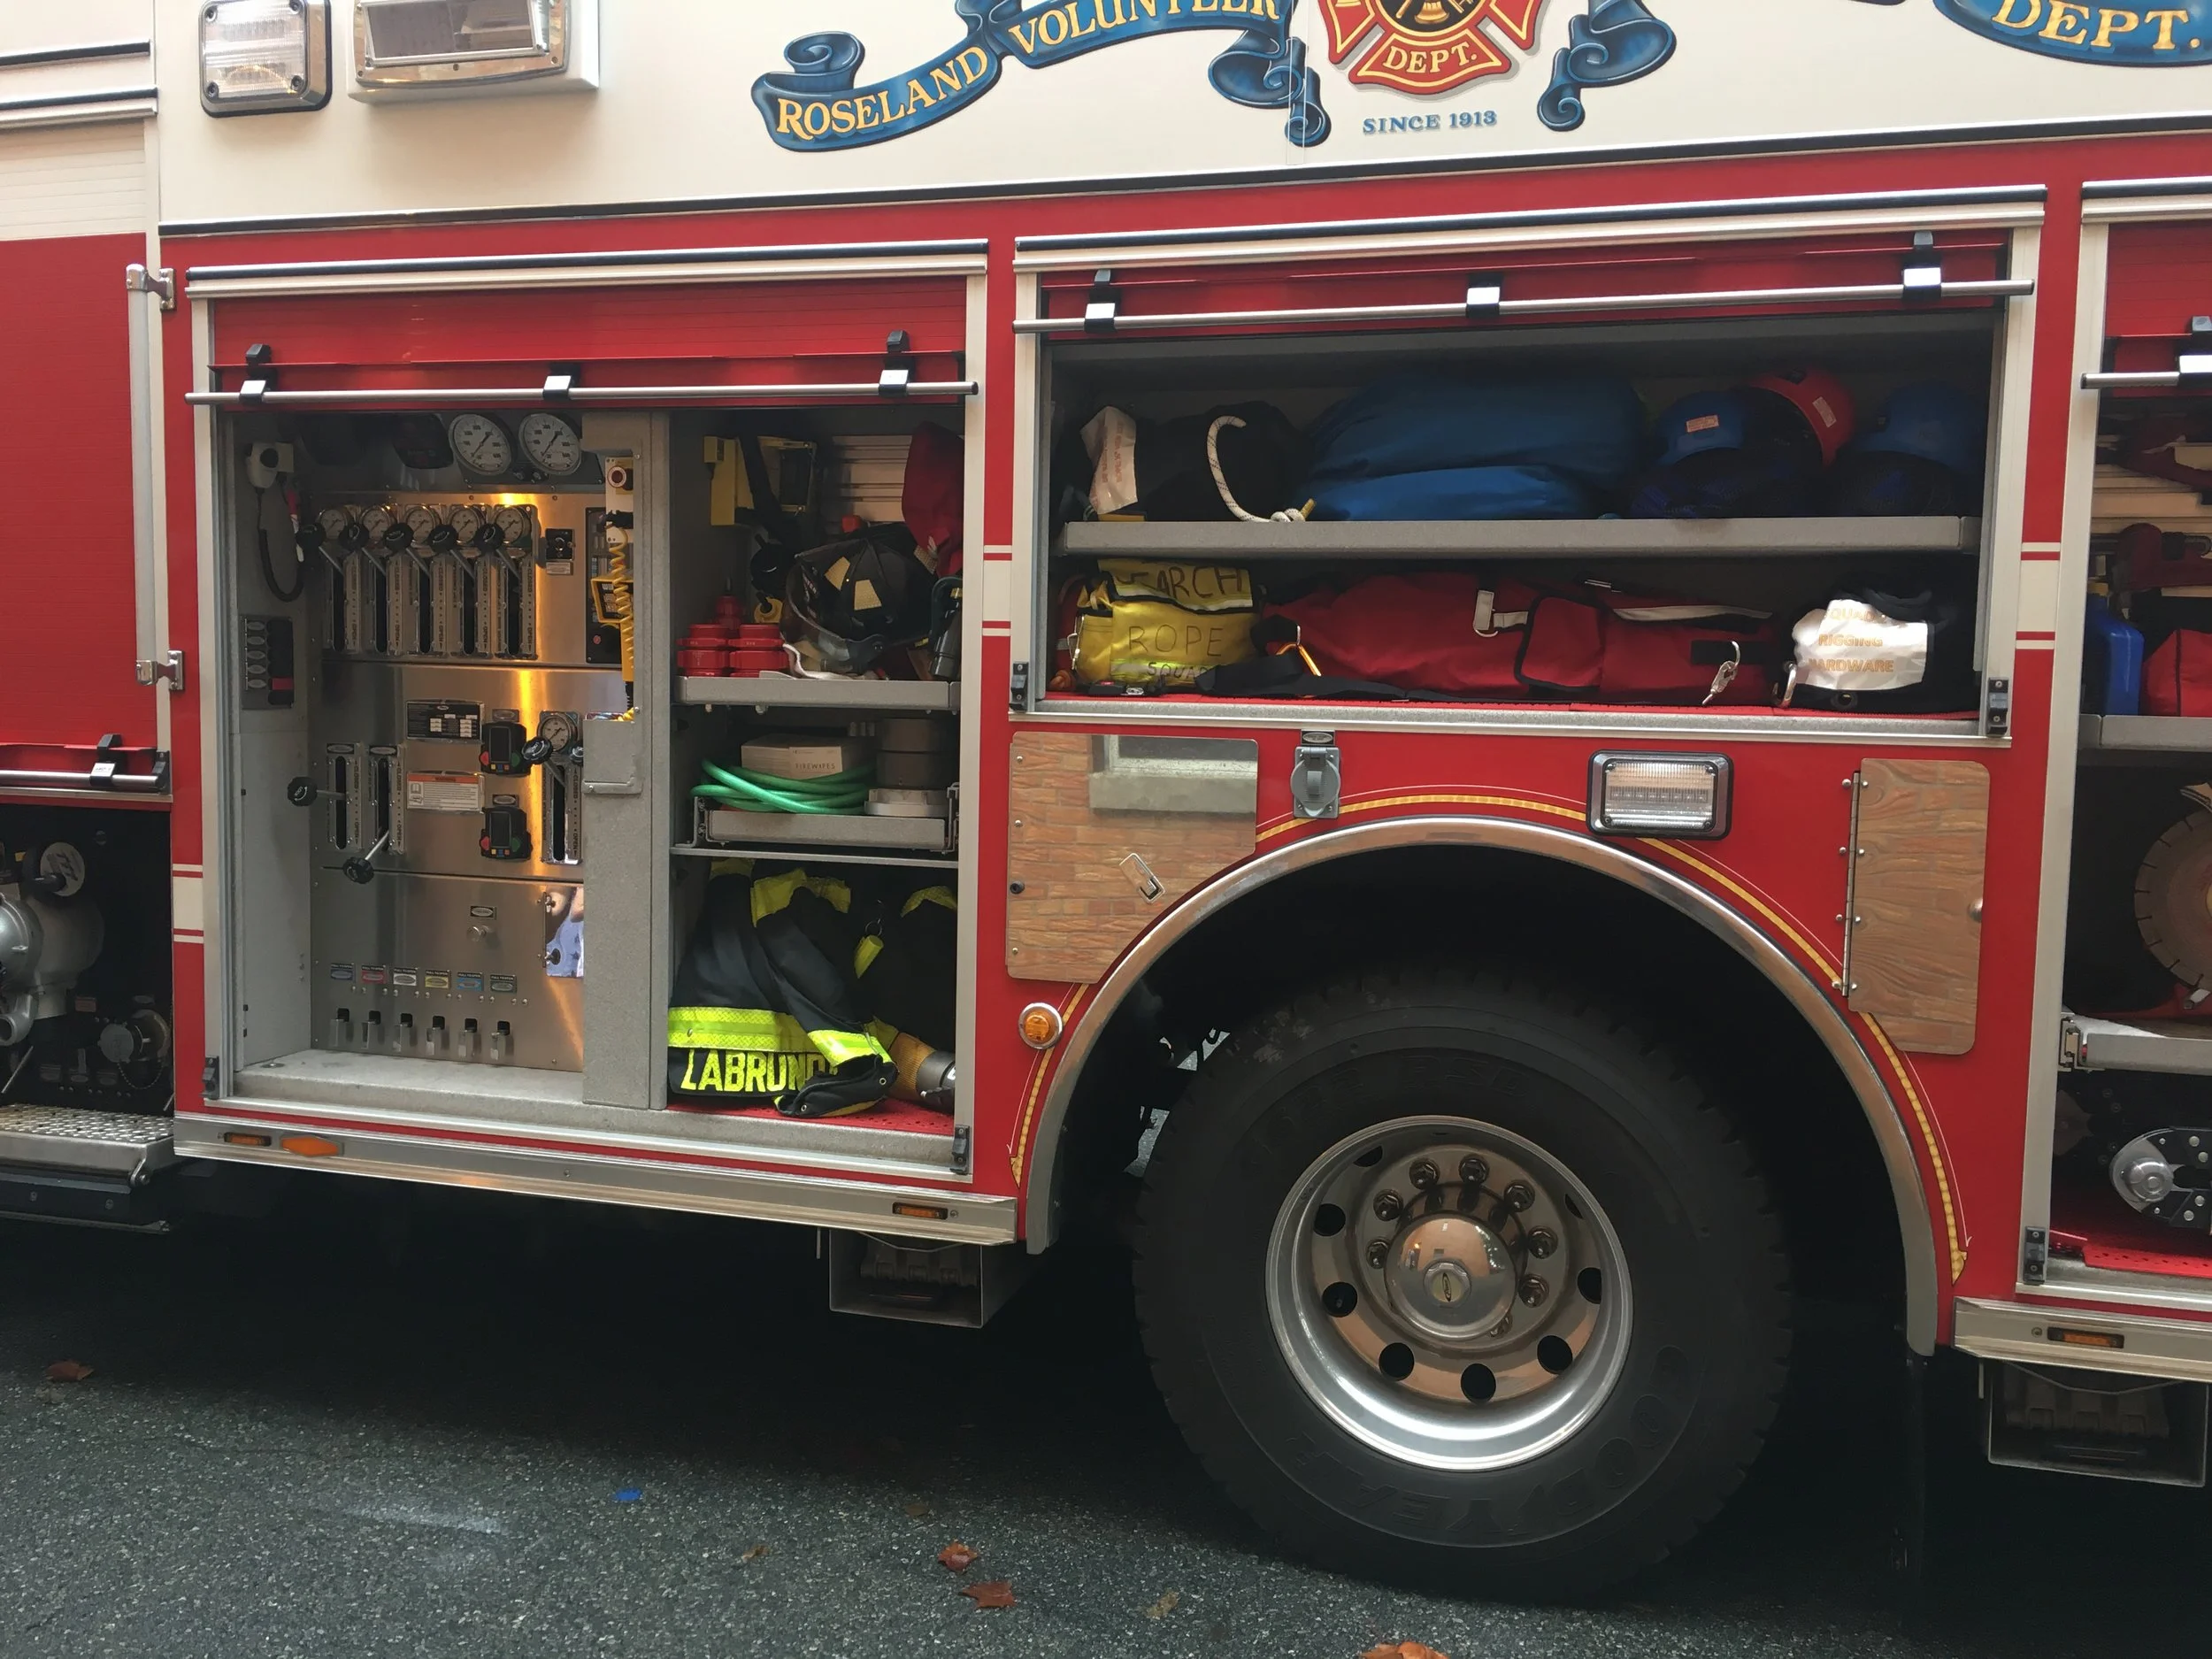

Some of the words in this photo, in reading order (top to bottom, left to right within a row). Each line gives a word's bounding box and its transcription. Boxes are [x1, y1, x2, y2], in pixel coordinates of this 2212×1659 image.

[1992, 0, 2200, 50] DEPT.
[1382, 42, 1478, 73] DEPT.
[775, 45, 988, 141] ROSELAND
[1363, 114, 1440, 134] SINCE
[1449, 110, 1498, 128] 1913
[1128, 624, 1224, 657] ROPE
[1818, 634, 1883, 647] RIGGING
[680, 1048, 839, 1093] LABRUN
